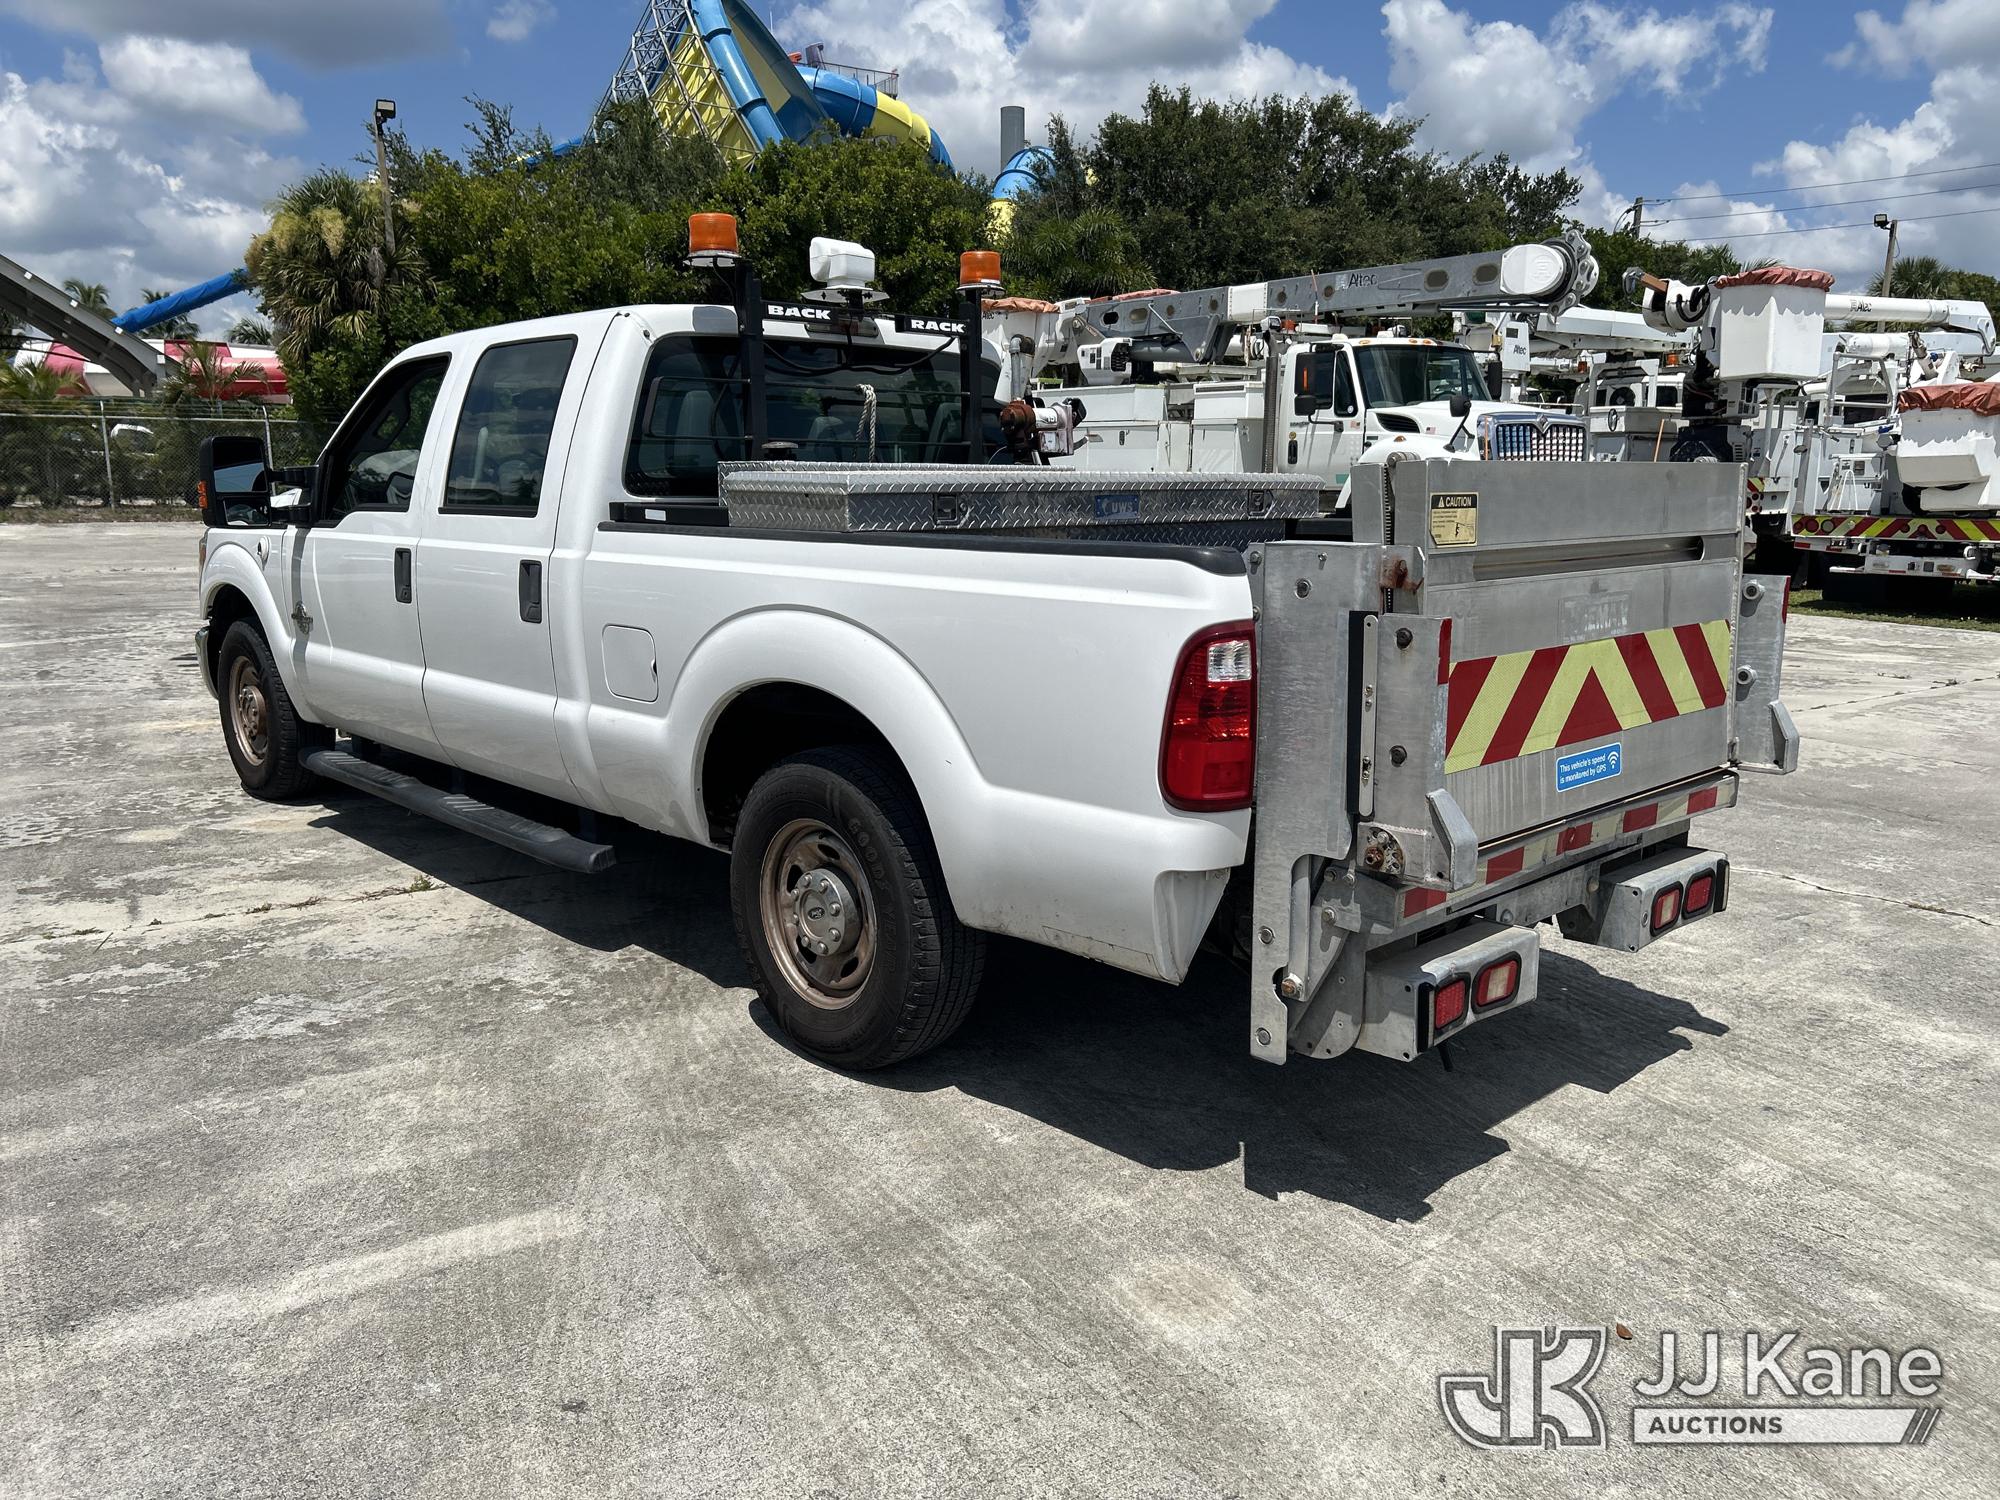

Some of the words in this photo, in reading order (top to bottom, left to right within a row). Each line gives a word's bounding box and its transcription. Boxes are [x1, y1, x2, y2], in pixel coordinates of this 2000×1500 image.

[1348, 273, 1378, 288] Altec
[767, 304, 831, 321] BACK
[911, 318, 965, 334] RACK
[1513, 344, 1527, 355] Altec
[1111, 501, 1133, 513] UWS
[1445, 496, 1472, 507] CAUTION
[1560, 764, 1571, 773] This
[1571, 757, 1591, 770] vehicle's
[1591, 753, 1606, 767] speed
[1560, 776, 1565, 784] is
[1565, 769, 1590, 782] monitored
[1590, 767, 1596, 777] by
[1596, 763, 1607, 774] GPS
